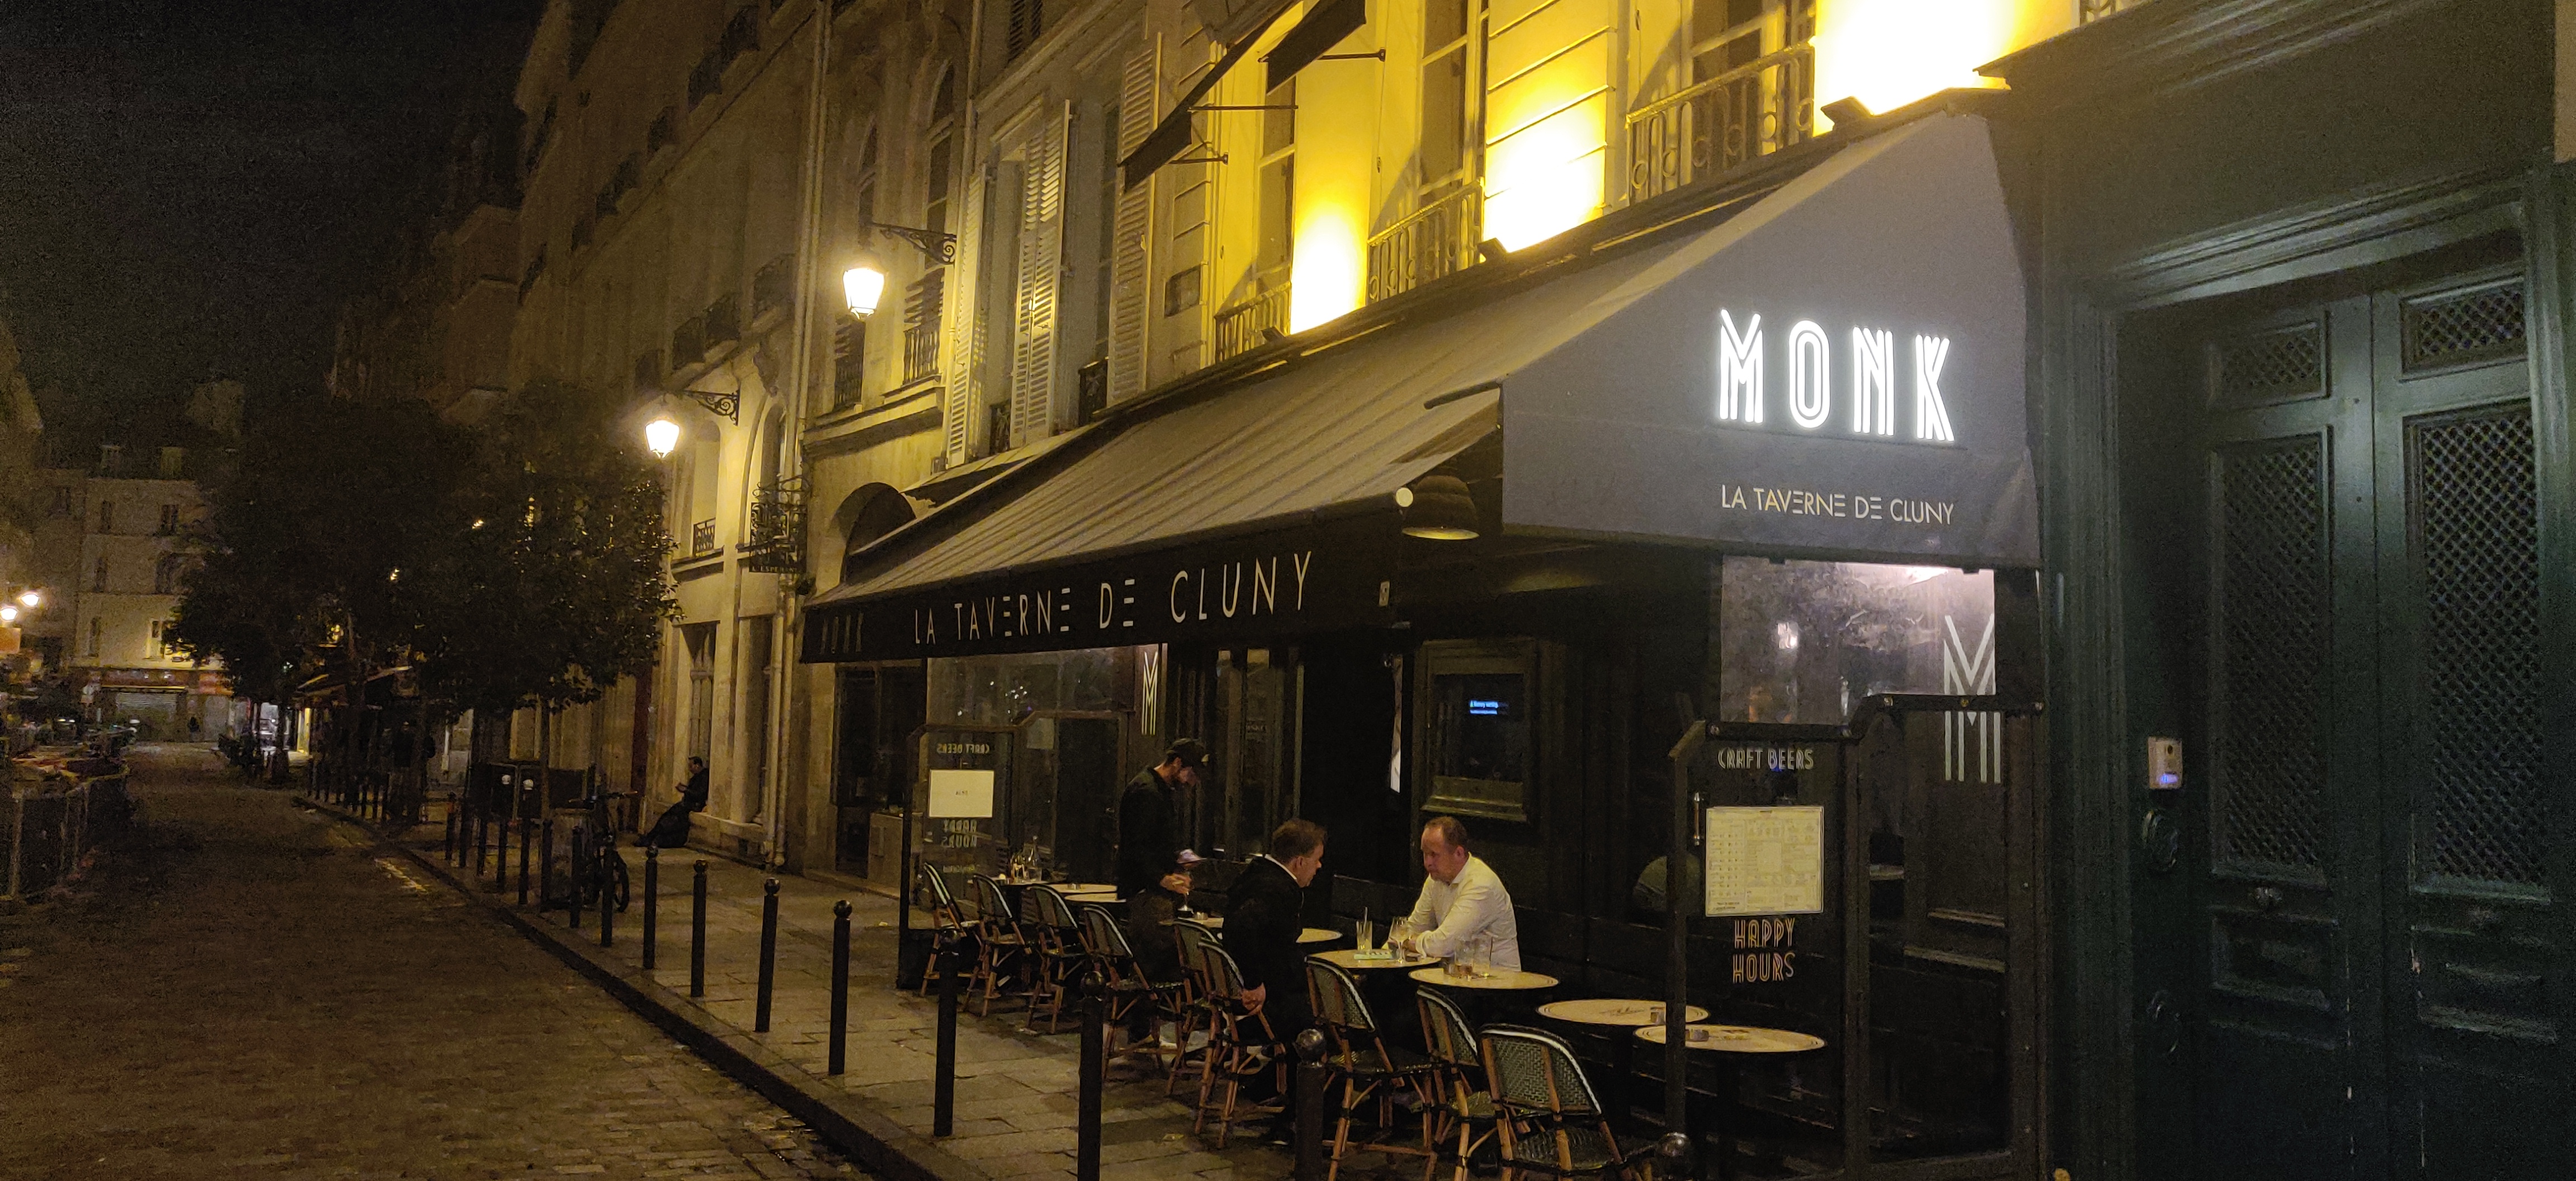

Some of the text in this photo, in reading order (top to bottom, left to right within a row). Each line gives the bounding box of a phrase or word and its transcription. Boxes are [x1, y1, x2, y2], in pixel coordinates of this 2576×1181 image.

[1720, 309, 1955, 442] MONK
[1722, 484, 1954, 525] LA TAVERNE DE CLUNY
[915, 551, 1312, 645] LA TAVERNE DE CLUNY
[1141, 651, 1159, 735] M
[1718, 747, 1814, 771] CRAFT BEERS
[1734, 918, 1796, 949] HAPPY
[1732, 952, 1796, 984] HOURS
